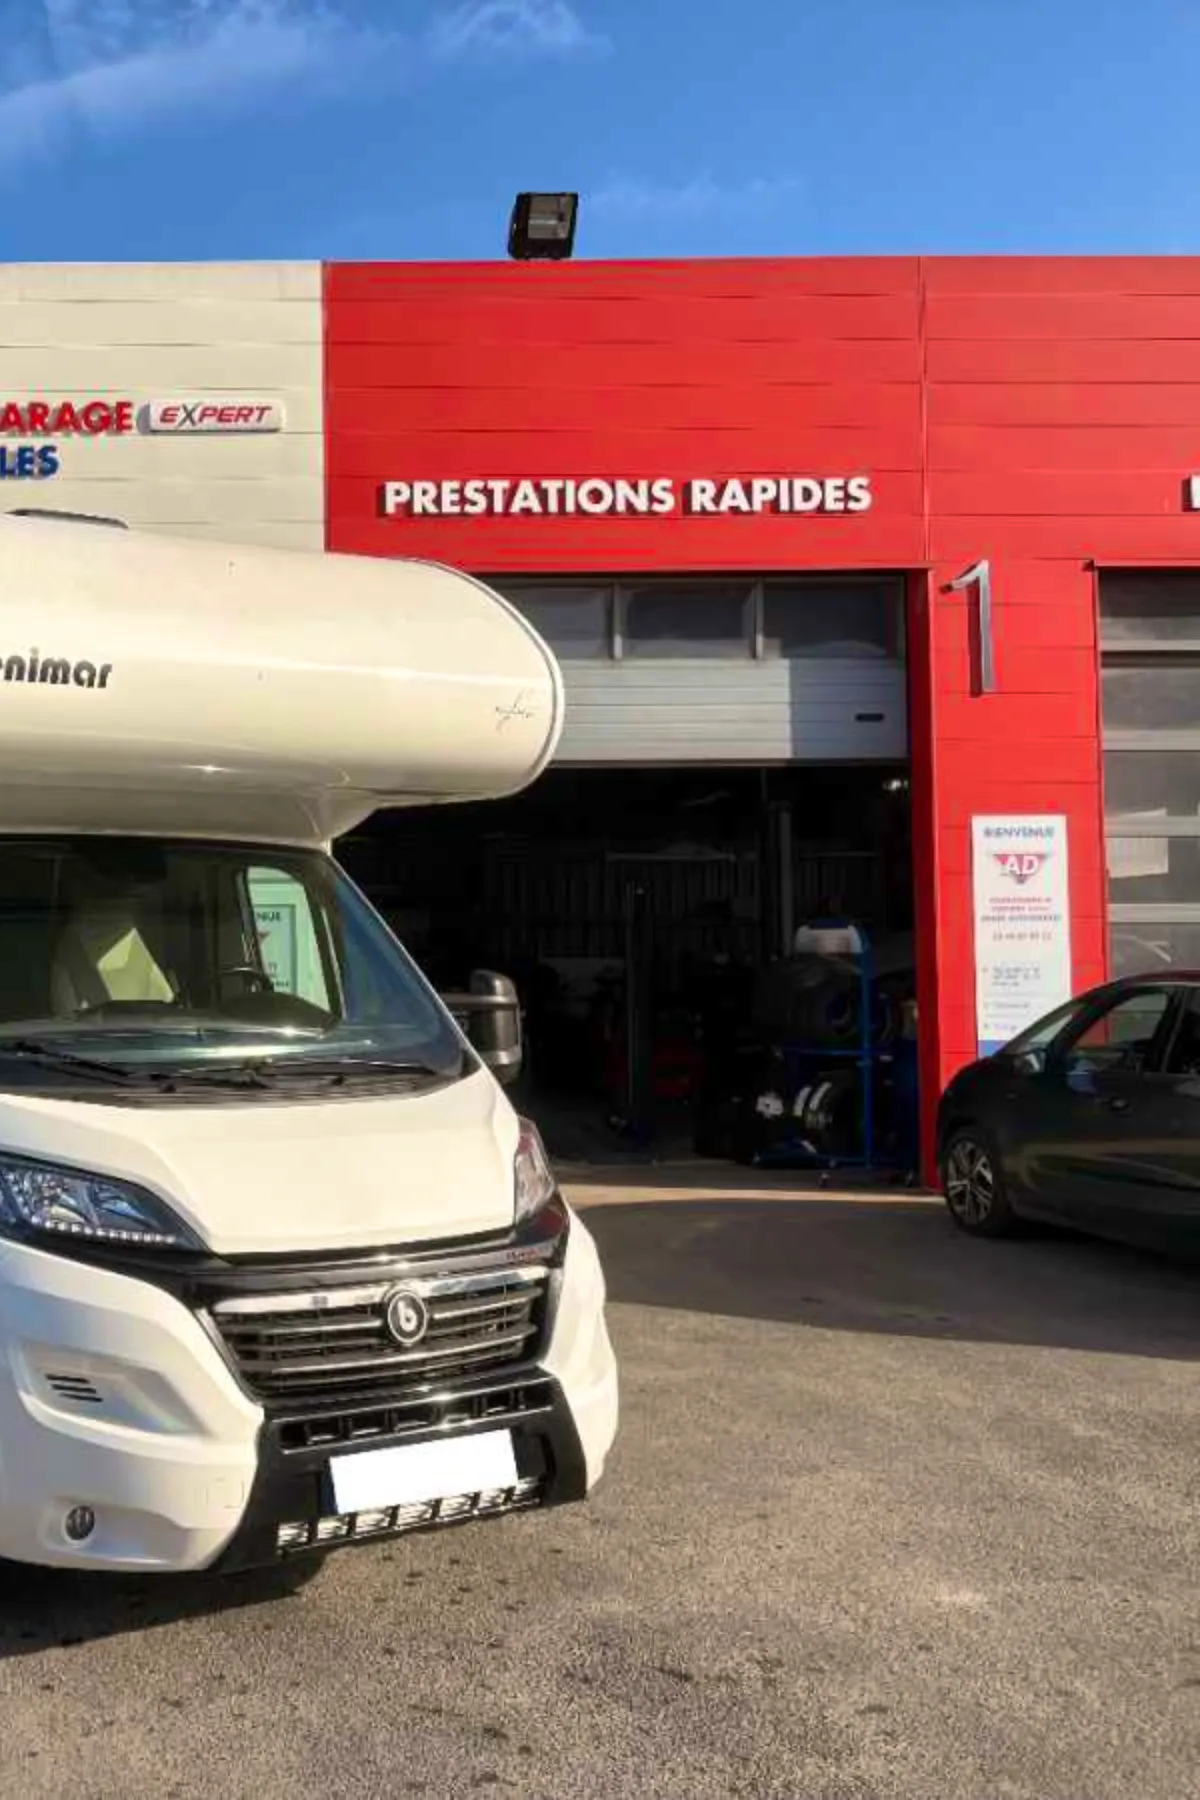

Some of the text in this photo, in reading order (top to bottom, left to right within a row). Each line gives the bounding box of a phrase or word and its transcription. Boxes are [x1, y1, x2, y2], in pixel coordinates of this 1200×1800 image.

[159, 403, 273, 427] EXPERT
[384, 477, 873, 514] PRESTATIONS RAPIDES
[951, 559, 995, 692] 1
[1005, 854, 1039, 876] AD
